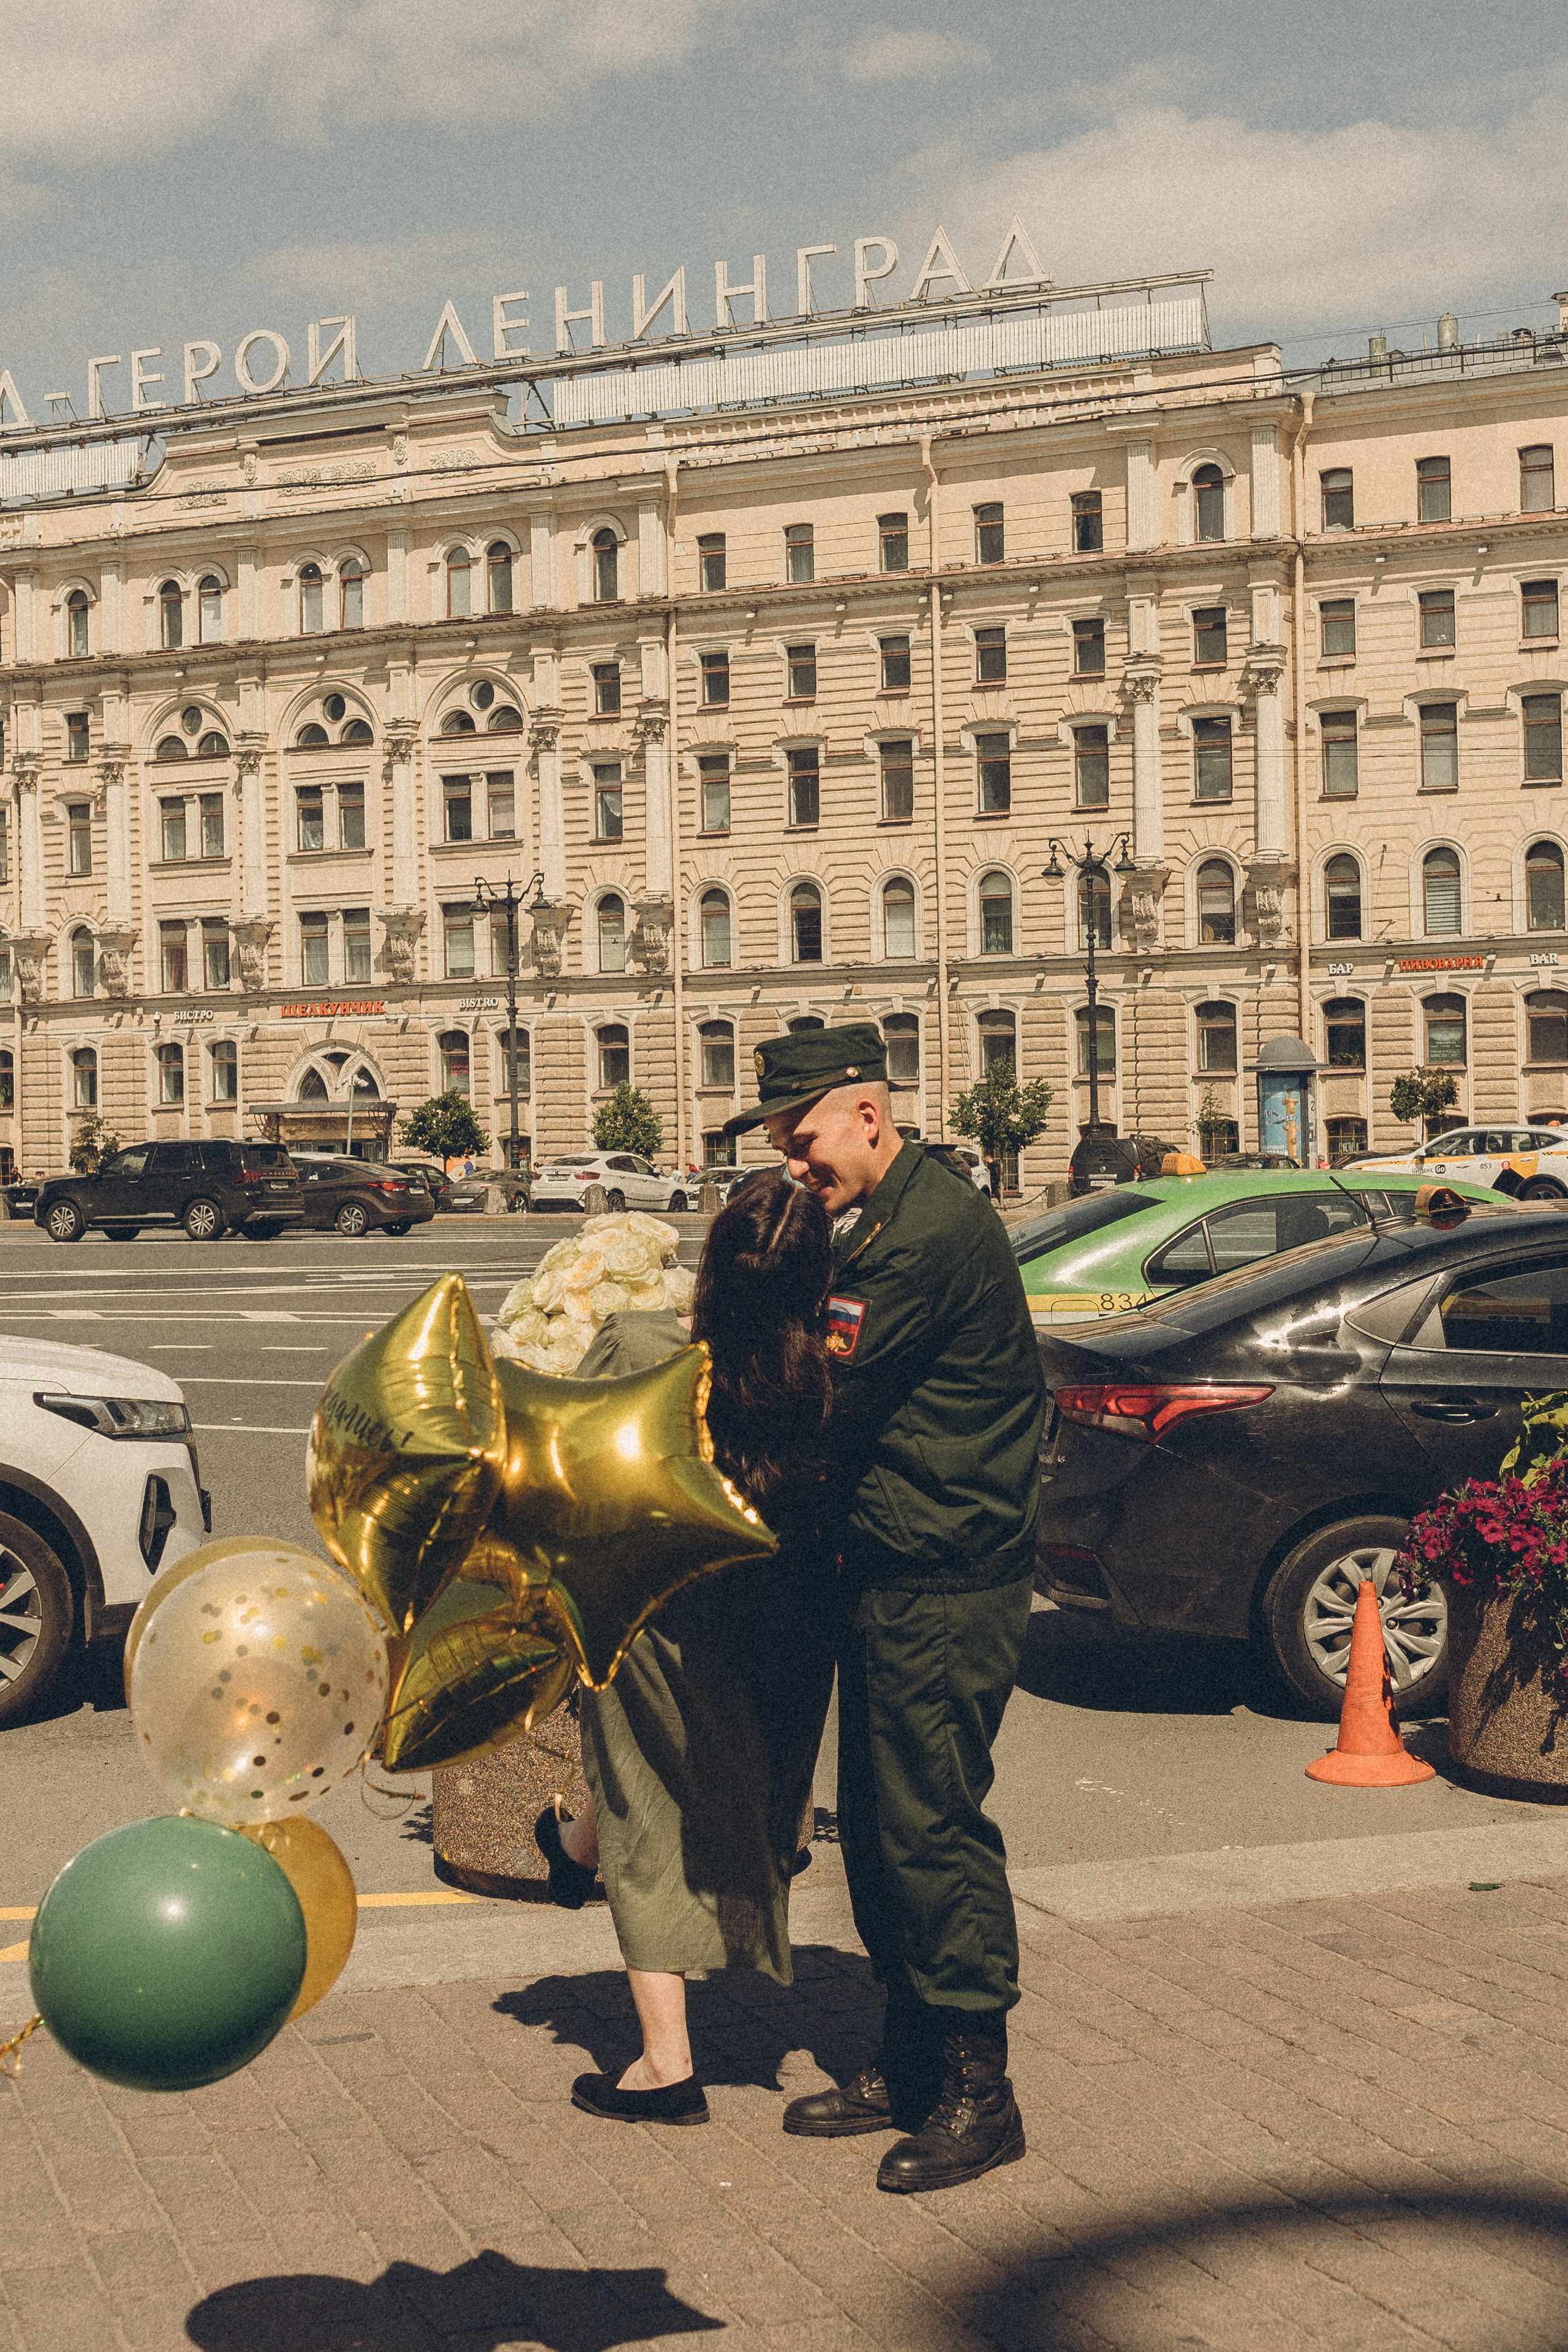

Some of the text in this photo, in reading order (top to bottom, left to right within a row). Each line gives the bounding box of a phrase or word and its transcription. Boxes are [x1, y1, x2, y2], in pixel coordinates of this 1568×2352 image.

[423, 213, 1050, 370] ЛЕНИНГРАД
[1400, 956, 1483, 972] ПИВОВАРНЯ
[1529, 952, 1558, 965] BAR
[1328, 962, 1354, 974] БАР
[281, 1000, 385, 1017] ЩЕЛКУНЧИК
[460, 997, 499, 1008] BISTRO
[174, 1010, 213, 1021] БИСТРО
[1100, 1293, 1147, 1310] 834
